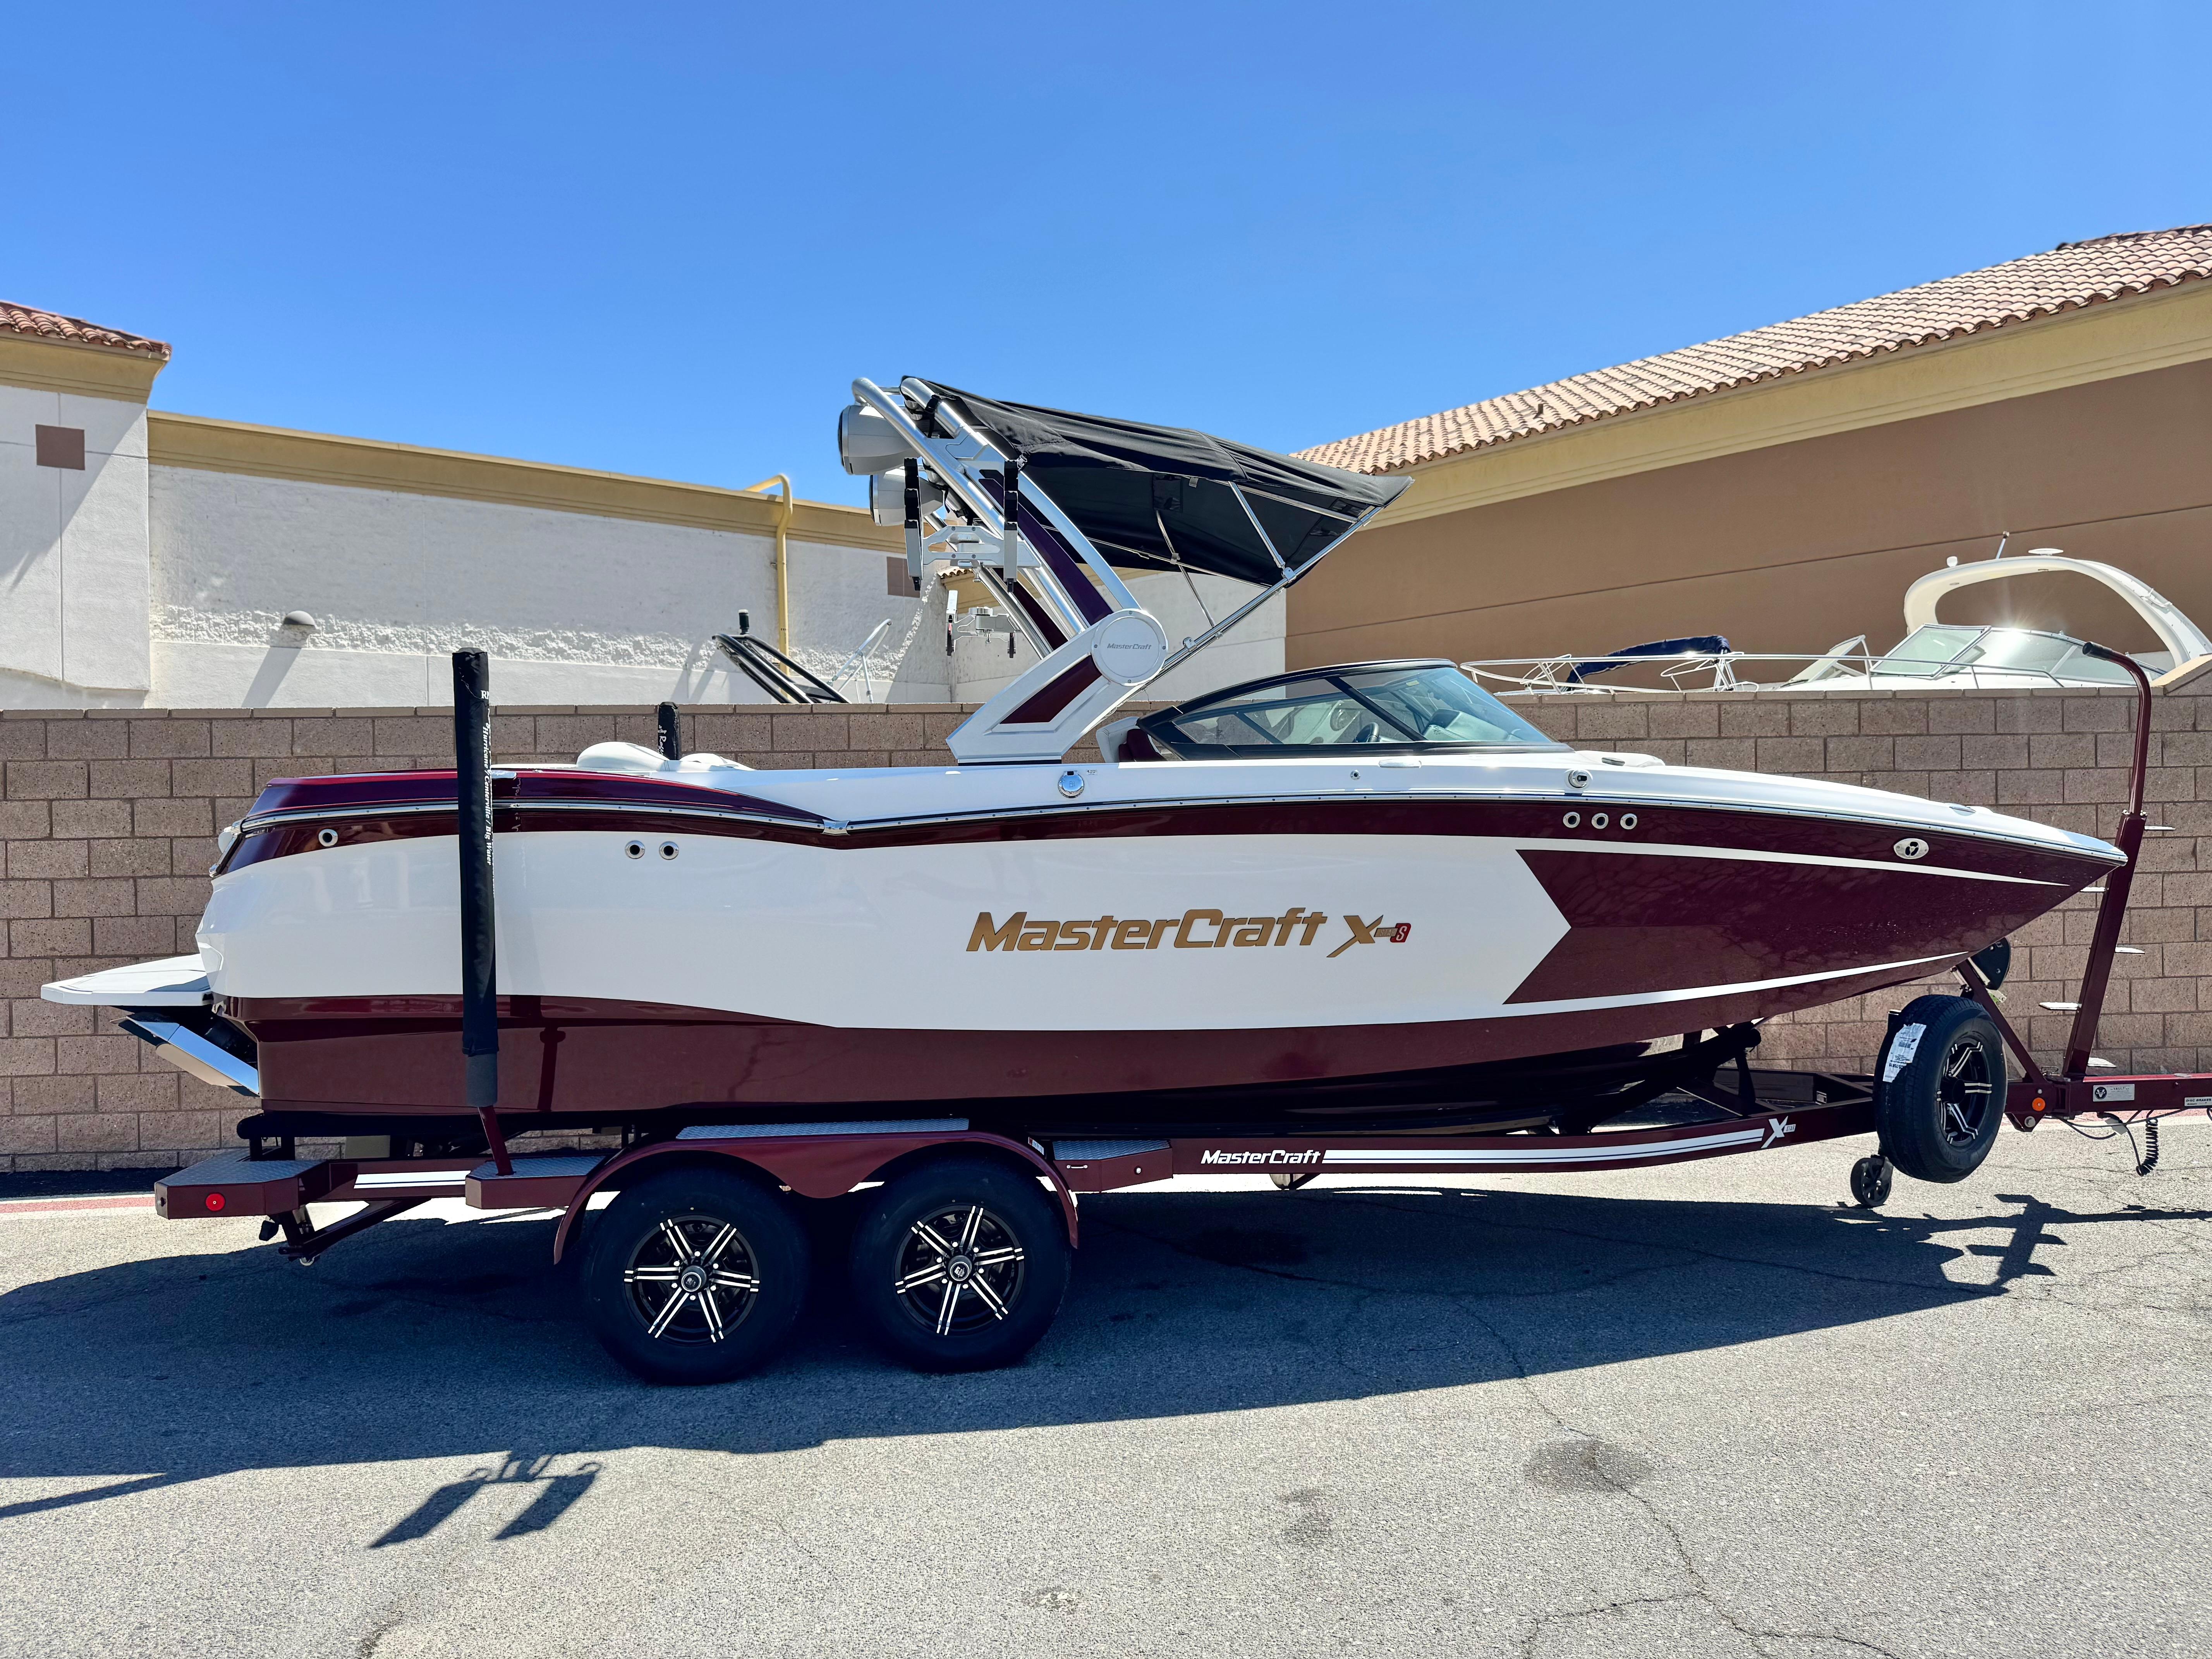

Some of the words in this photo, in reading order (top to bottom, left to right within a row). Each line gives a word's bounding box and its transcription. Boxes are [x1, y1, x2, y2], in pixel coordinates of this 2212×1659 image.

[966, 907, 1328, 951] MasterCraft
[1326, 915, 1383, 958] X
[1379, 929, 1397, 937] STAR
[1396, 926, 1408, 941] S
[1761, 1116, 1788, 1149] X
[1200, 1149, 1321, 1164] MasterCraft
